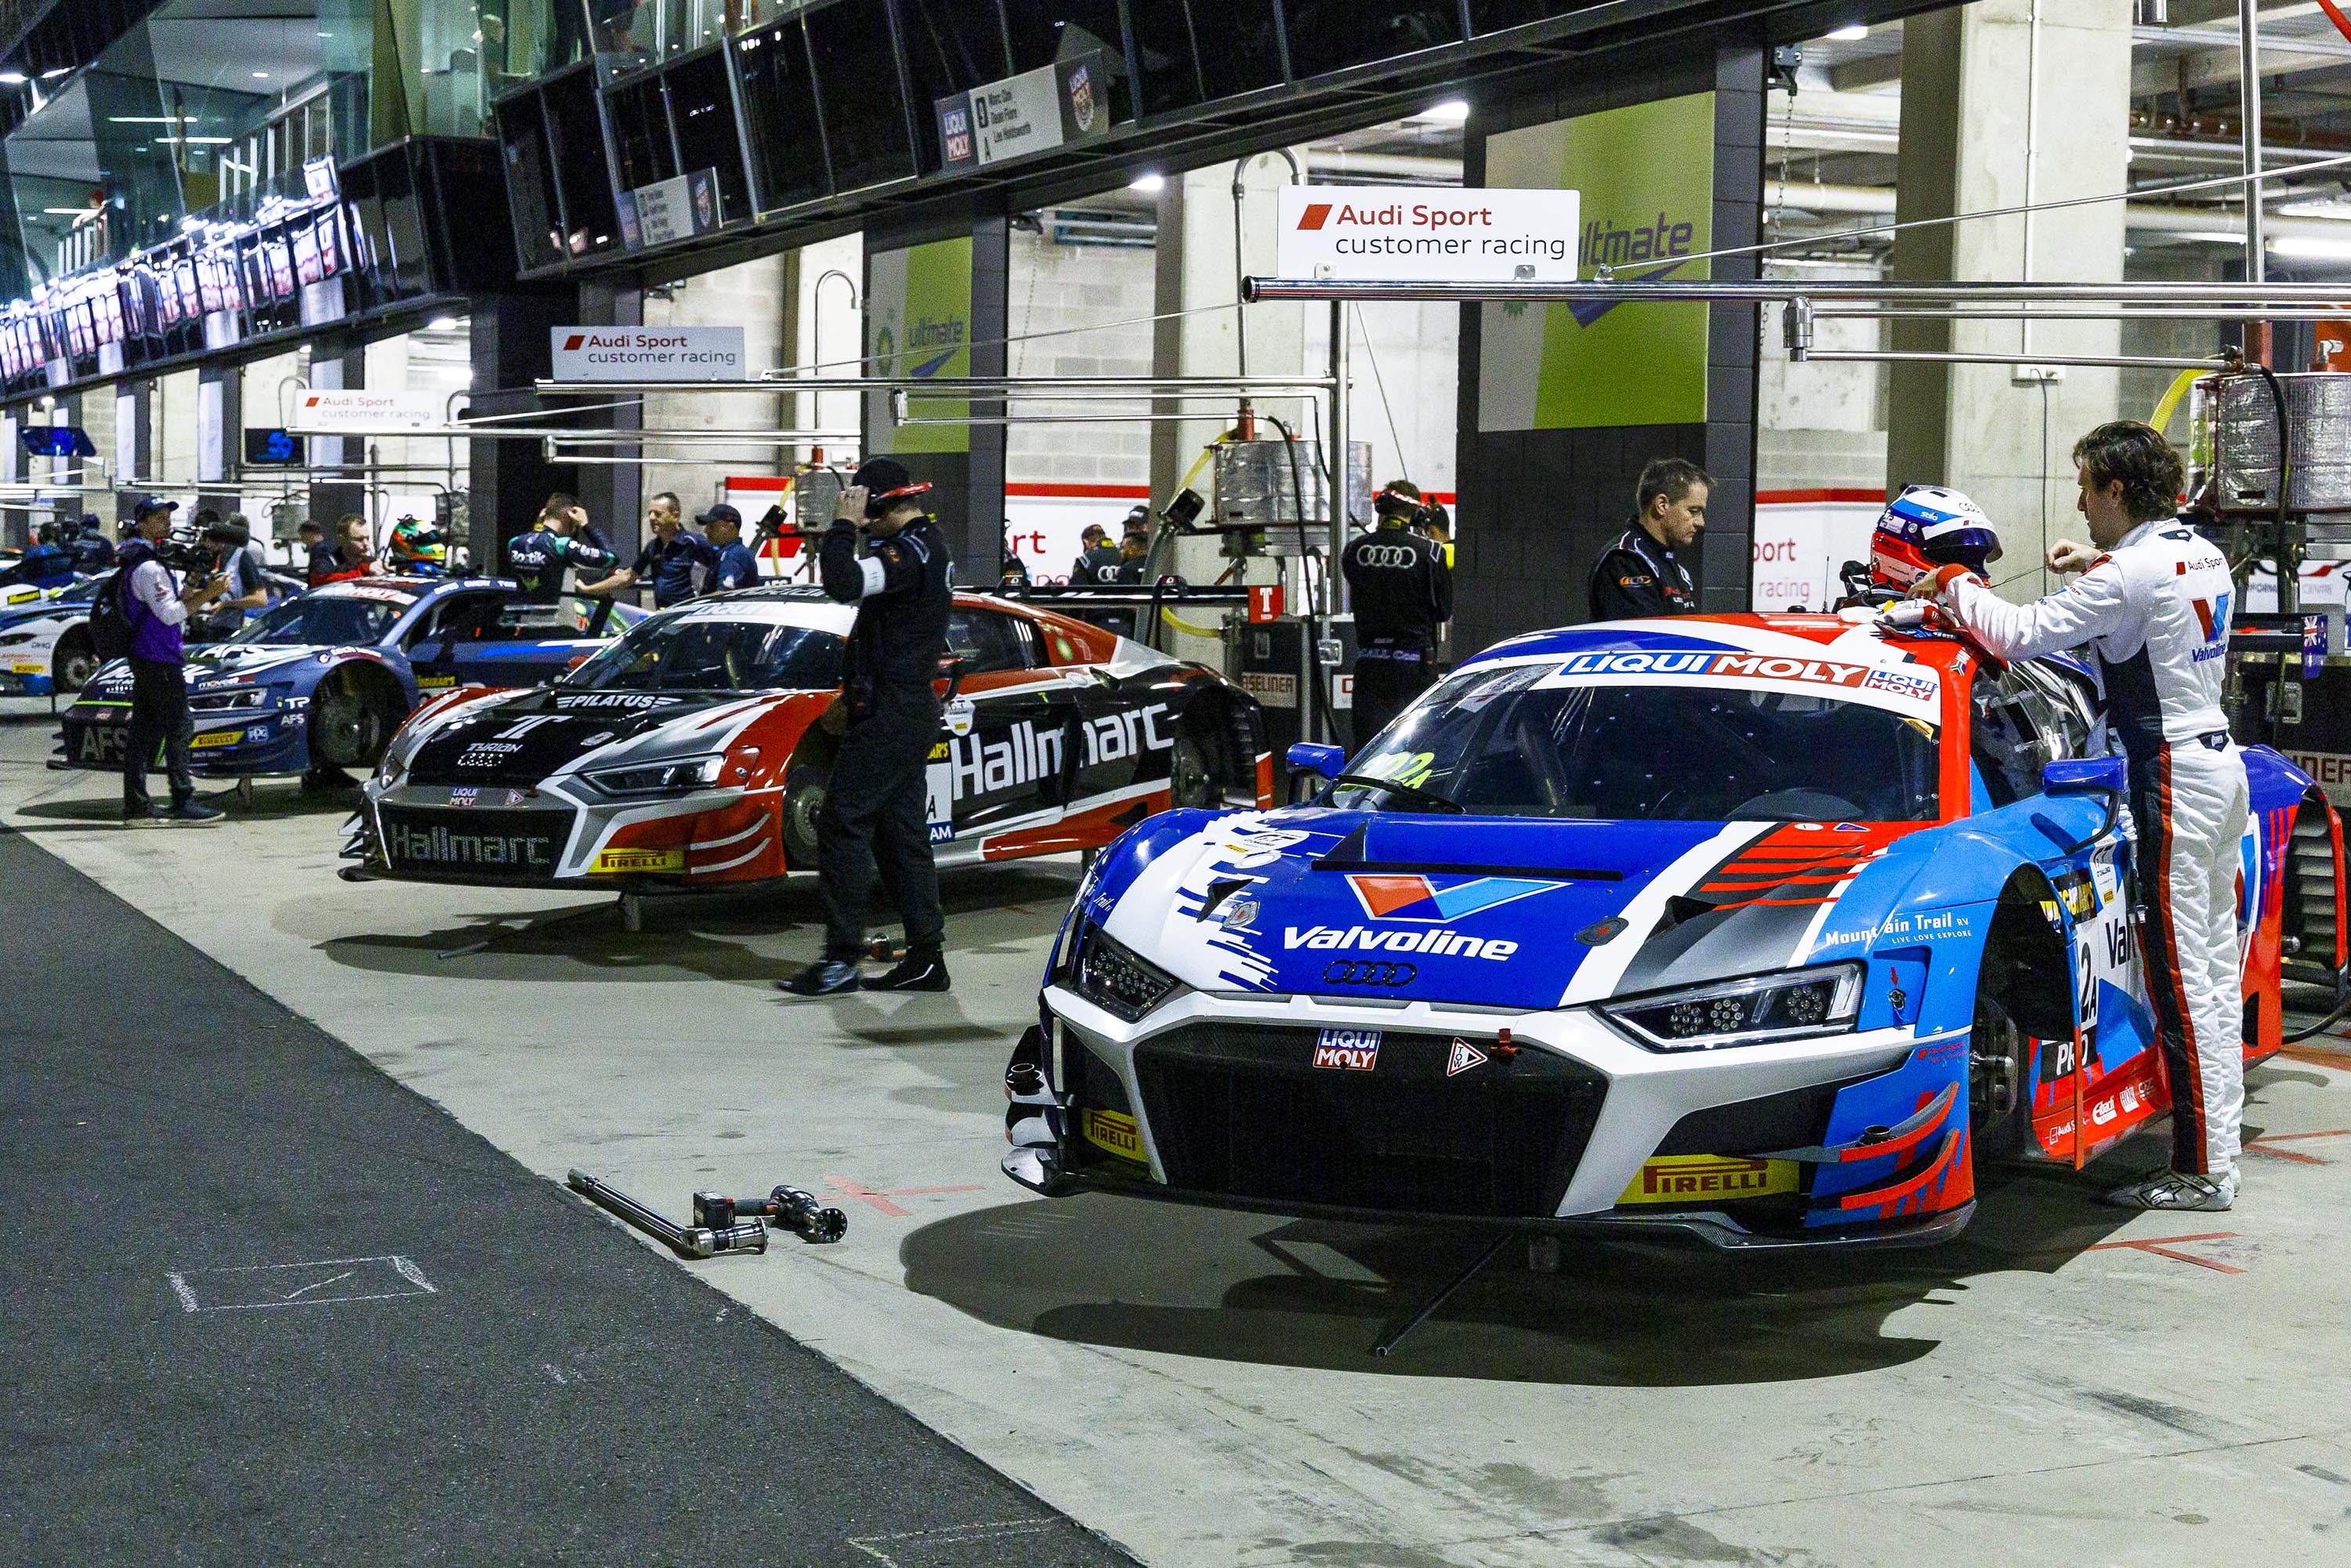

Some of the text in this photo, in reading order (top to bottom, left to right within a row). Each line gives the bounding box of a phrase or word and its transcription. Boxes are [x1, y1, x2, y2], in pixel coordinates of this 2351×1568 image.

[1336, 205, 1493, 230] Audi Sport
[1335, 234, 1566, 261] customer racing
[589, 335, 687, 351] Audi Sport
[588, 349, 736, 366] customer racing
[322, 397, 395, 408] Audi Sport
[321, 408, 430, 421] customer racing
[2187, 559, 2204, 572] Audi
[1759, 576, 1810, 603] racing
[1571, 654, 1867, 683] LIQUI MOLY
[1241, 674, 1294, 693] SELINER
[1868, 679, 1933, 701] MOLY
[1873, 671, 1936, 691] LIQUI
[571, 694, 657, 708] PILATUS
[281, 713, 305, 726] AFS
[466, 743, 523, 753] TYRIAN
[450, 796, 476, 806] MOLY
[452, 788, 478, 797] LIQUI
[392, 823, 550, 865] Hallmarc
[600, 849, 666, 868] PIRELLI
[1826, 911, 1969, 945] Mountain Trail RV
[1892, 930, 1972, 945] LIVE LOVE EXPLORE
[1284, 925, 1519, 961] Valvoline
[1321, 1030, 1378, 1049] LIQUI
[1317, 1048, 1375, 1069] MOLY
[1454, 1046, 1464, 1068] TOW
[1089, 1111, 1136, 1151] PIRELLI
[2058, 1124, 2071, 1137] Audi
[1643, 1160, 1768, 1194] PIRELLI
